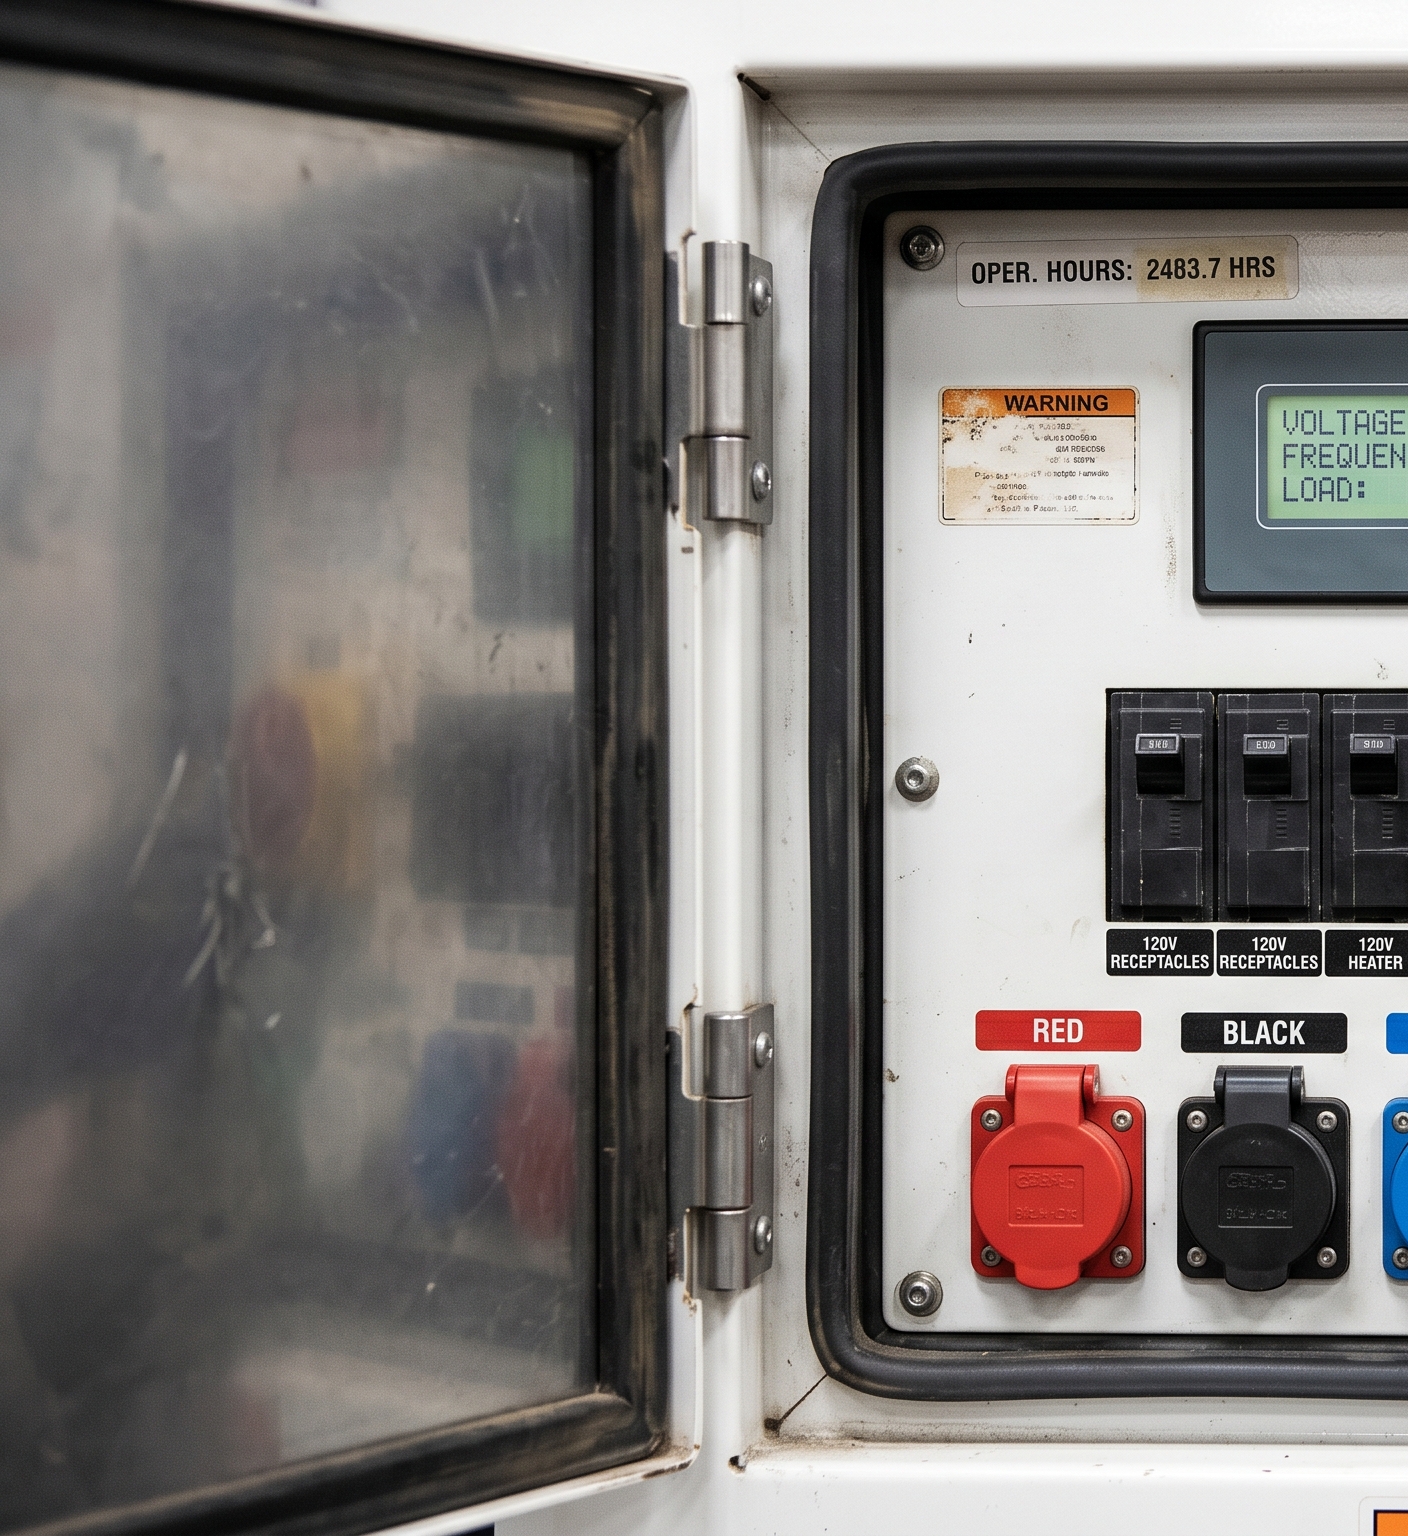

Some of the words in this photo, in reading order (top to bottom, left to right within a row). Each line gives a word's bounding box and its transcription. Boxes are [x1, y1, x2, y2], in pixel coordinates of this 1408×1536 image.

[972, 262, 1037, 284] OPER.
[1048, 259, 1131, 282] HOURS:
[1147, 258, 1220, 280] 2483.7
[1230, 256, 1275, 278] HRS
[1004, 395, 1108, 411] WARNING
[1284, 477, 1364, 502] LOAD:
[1143, 937, 1177, 950] 120V
[1252, 937, 1286, 951] 120V
[1359, 938, 1393, 951] 120V
[1111, 954, 1209, 969] RECEPTACLES
[1220, 955, 1318, 969] RECEPTACLES
[1349, 956, 1402, 969] HEATER
[1034, 1019, 1083, 1042] RED
[1224, 1020, 1305, 1044] BLACK
